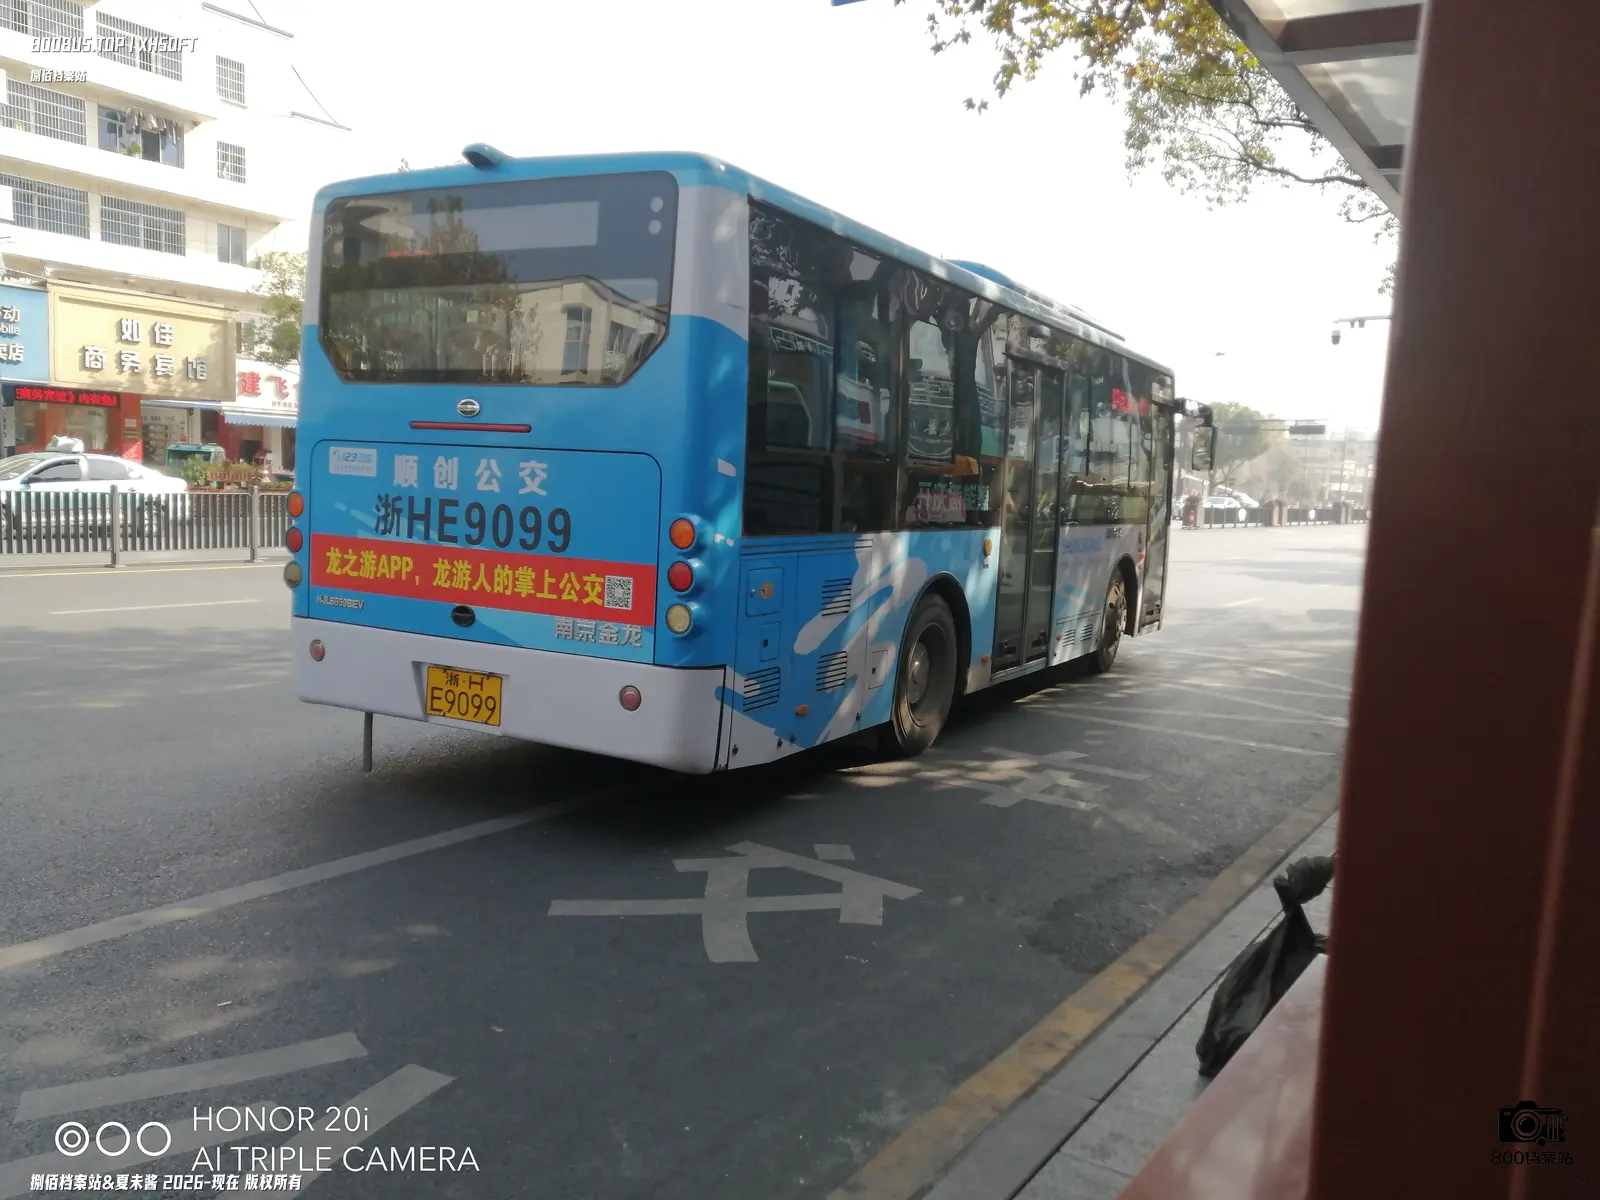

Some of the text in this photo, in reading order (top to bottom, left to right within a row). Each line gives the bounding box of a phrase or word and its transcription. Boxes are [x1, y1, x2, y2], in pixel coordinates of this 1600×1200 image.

[0, 305, 20, 323] 动
[0, 323, 20, 336] bile
[82, 345, 208, 381] 商务宾馆
[238, 371, 299, 399] 建飞
[393, 454, 548, 496] 顺创公交
[374, 494, 572, 553] 浙HE9099
[554, 617, 643, 647] 南京金龙
[430, 686, 497, 724] E9099
